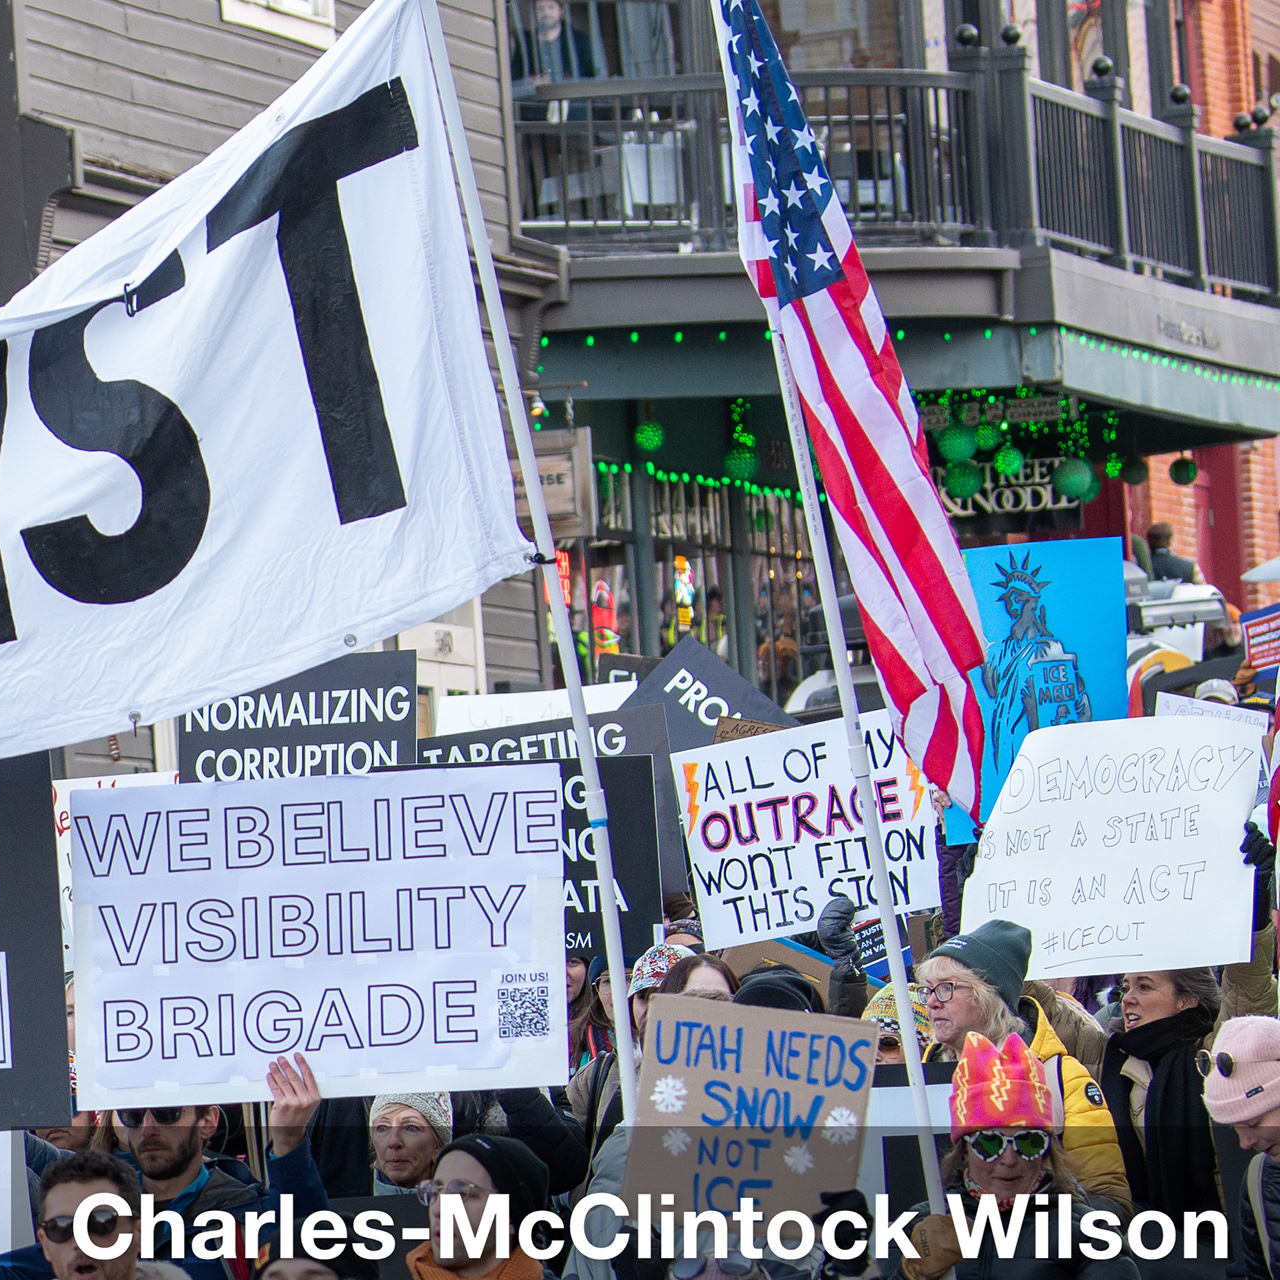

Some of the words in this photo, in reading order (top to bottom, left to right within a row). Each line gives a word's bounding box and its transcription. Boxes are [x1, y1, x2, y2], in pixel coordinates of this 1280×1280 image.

[968, 484, 1081, 514] NOODL
[664, 667, 744, 727] PRO
[1038, 682, 1075, 706] MELT
[1043, 663, 1068, 684] ICE
[185, 685, 411, 733] NORMALIZING
[195, 739, 398, 784] CORRUPTION
[704, 755, 775, 802] ALL
[782, 741, 827, 783] OF
[1000, 745, 1255, 814] DEMOCRACY
[224, 789, 560, 870] BELIEVE
[814, 836, 873, 879] FIT
[885, 825, 926, 862] ON
[1005, 824, 1052, 857] NOT
[1070, 820, 1088, 848] A
[1102, 804, 1201, 848] STATE
[722, 885, 815, 934] THIS
[988, 880, 1017, 913] IT
[1027, 877, 1053, 907] IS
[1071, 873, 1107, 906] AN
[1123, 860, 1207, 906] ACT
[99, 884, 526, 966] VISIBILITY
[1041, 921, 1146, 956] #ICEOUT
[500, 972, 527, 985] JOIN
[528, 971, 550, 983] US!
[103, 979, 479, 1064] BRIGADE
[655, 1019, 745, 1075] UTAH
[765, 1029, 873, 1092] NEEDS
[701, 1079, 825, 1141] SNOW
[697, 1135, 772, 1172] NOT
[692, 1172, 774, 1224] ICE
